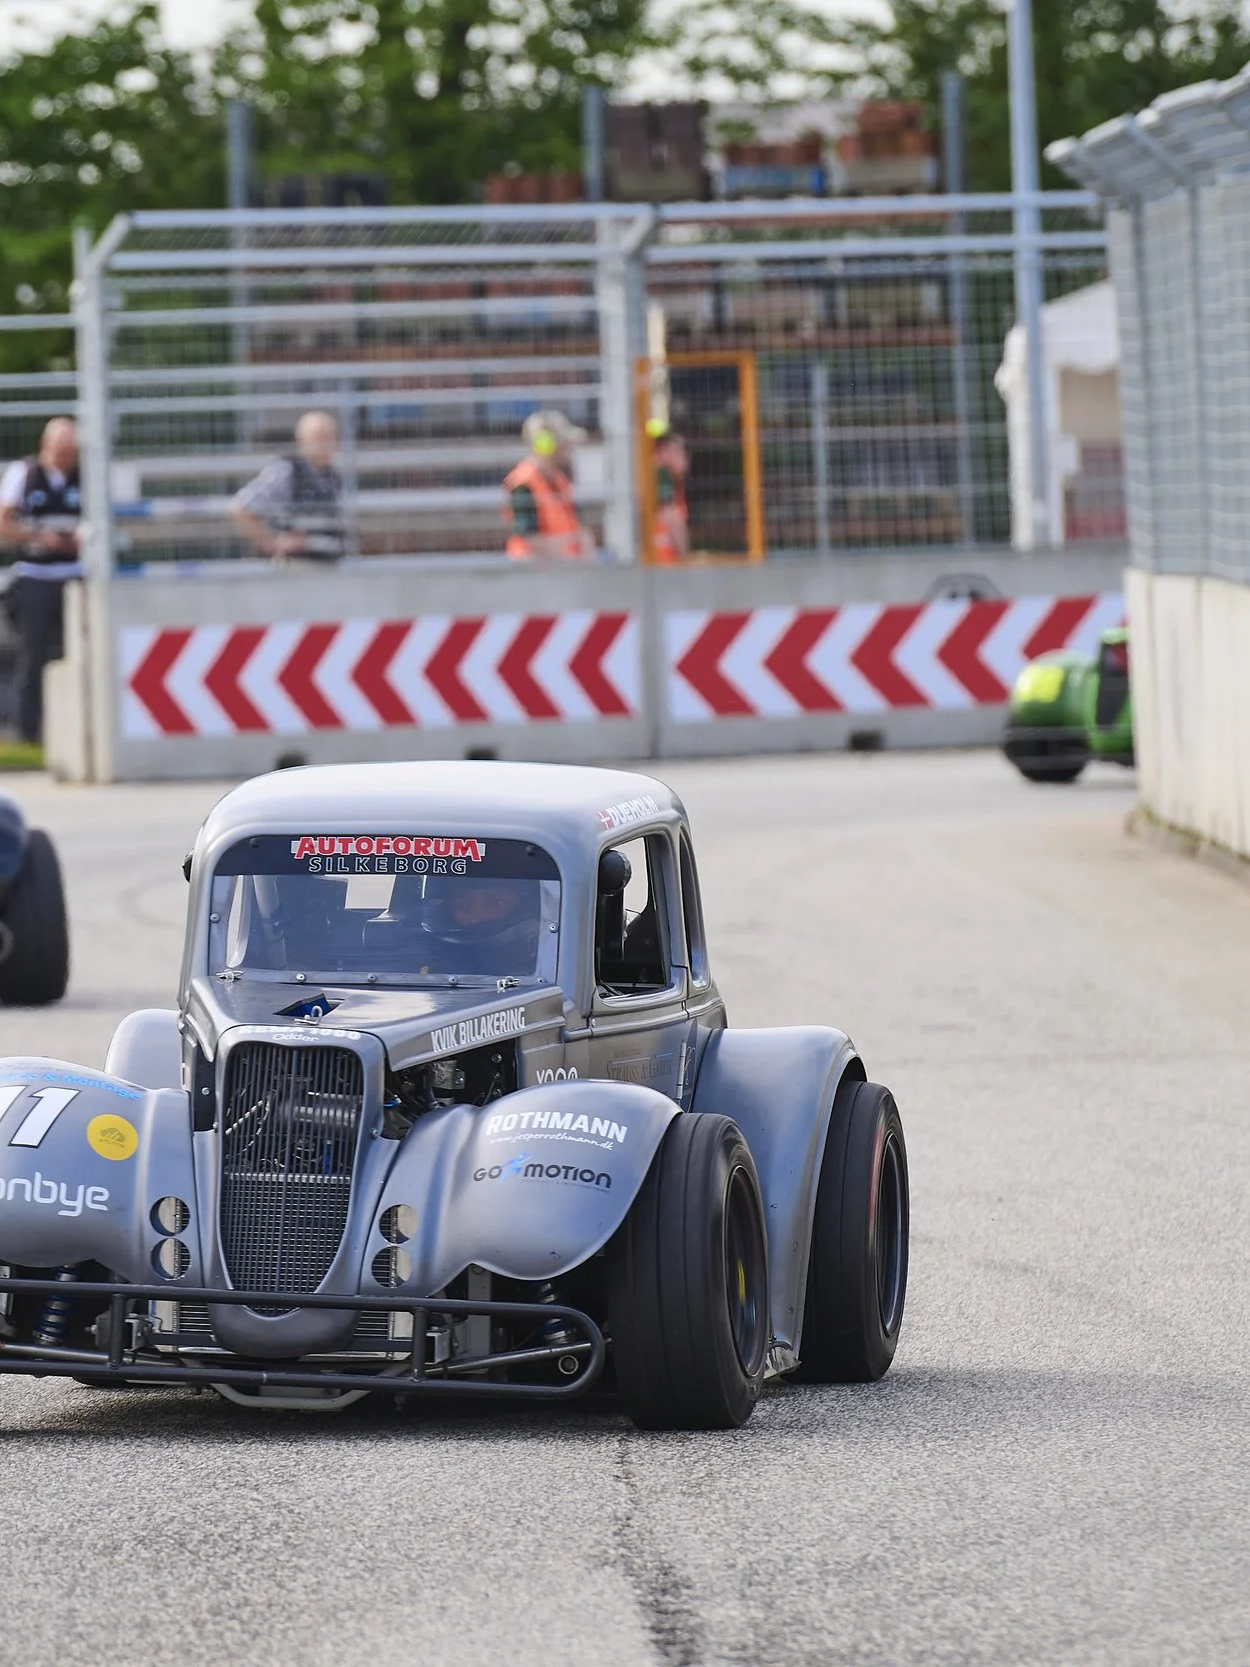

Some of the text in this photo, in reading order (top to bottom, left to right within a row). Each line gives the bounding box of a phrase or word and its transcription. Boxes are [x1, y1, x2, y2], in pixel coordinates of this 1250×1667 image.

[294, 837, 481, 861] AUTOFORUM
[308, 857, 467, 874] SILKEBORG
[272, 1033, 319, 1042] Odder
[430, 1006, 526, 1053] KVIK BILLAKERING
[486, 1111, 628, 1144] ROTHMANN
[473, 1165, 503, 1182] GO
